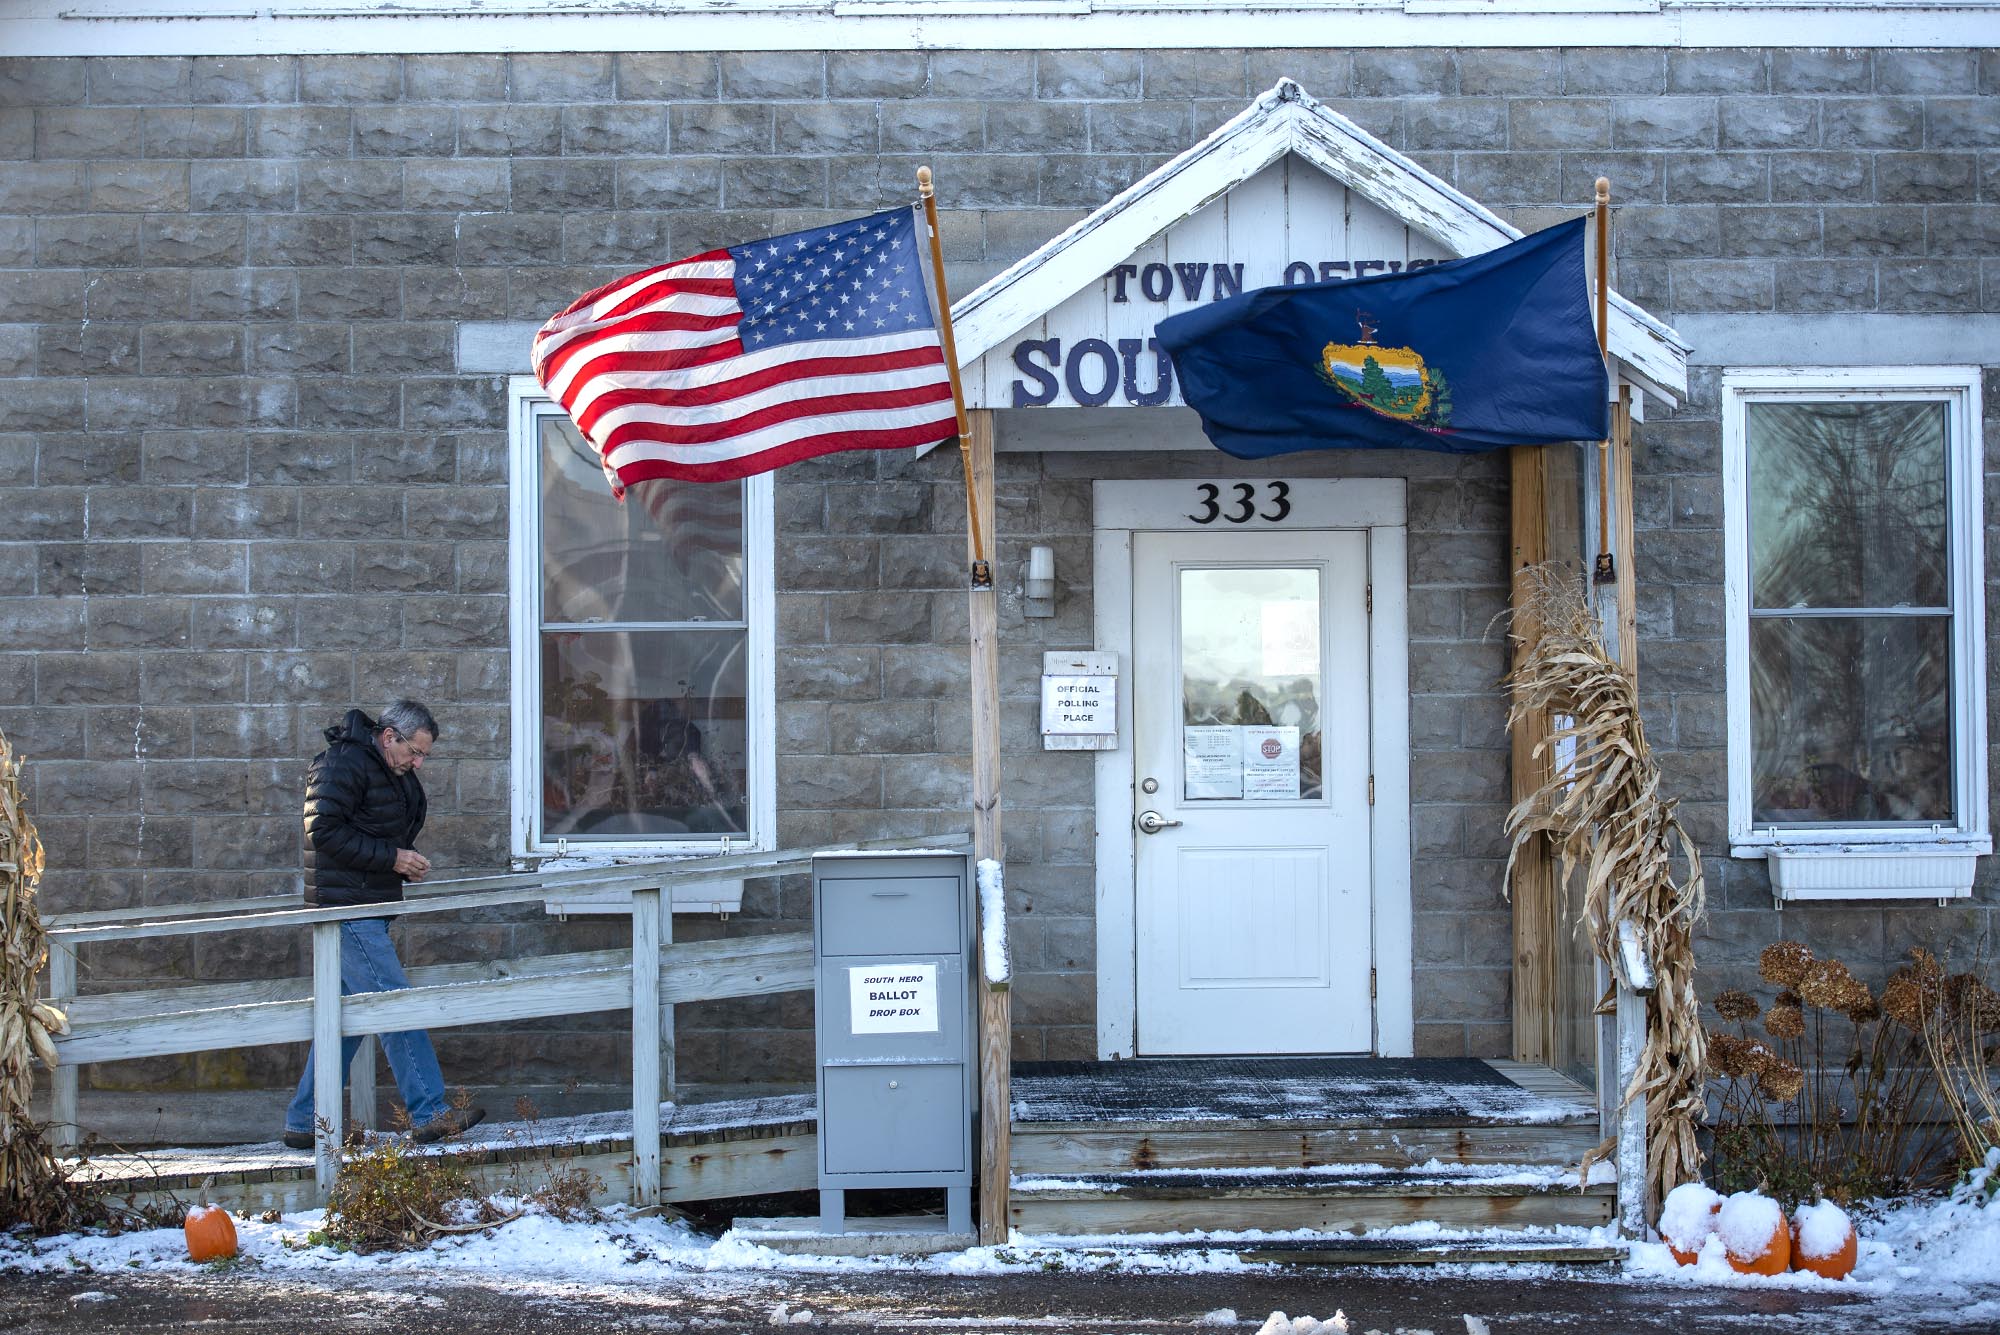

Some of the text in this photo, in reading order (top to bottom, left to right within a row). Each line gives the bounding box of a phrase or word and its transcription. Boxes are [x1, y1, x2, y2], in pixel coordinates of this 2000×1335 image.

[1105, 263, 1244, 302] TOWN
[1186, 480, 1291, 525] 333
[1057, 685, 1100, 693] OFFICIAL
[1063, 714, 1094, 722] PLACE
[1262, 744, 1281, 753] STOP
[869, 990, 917, 1000] BALLOT
[899, 1008, 920, 1016] BOX
